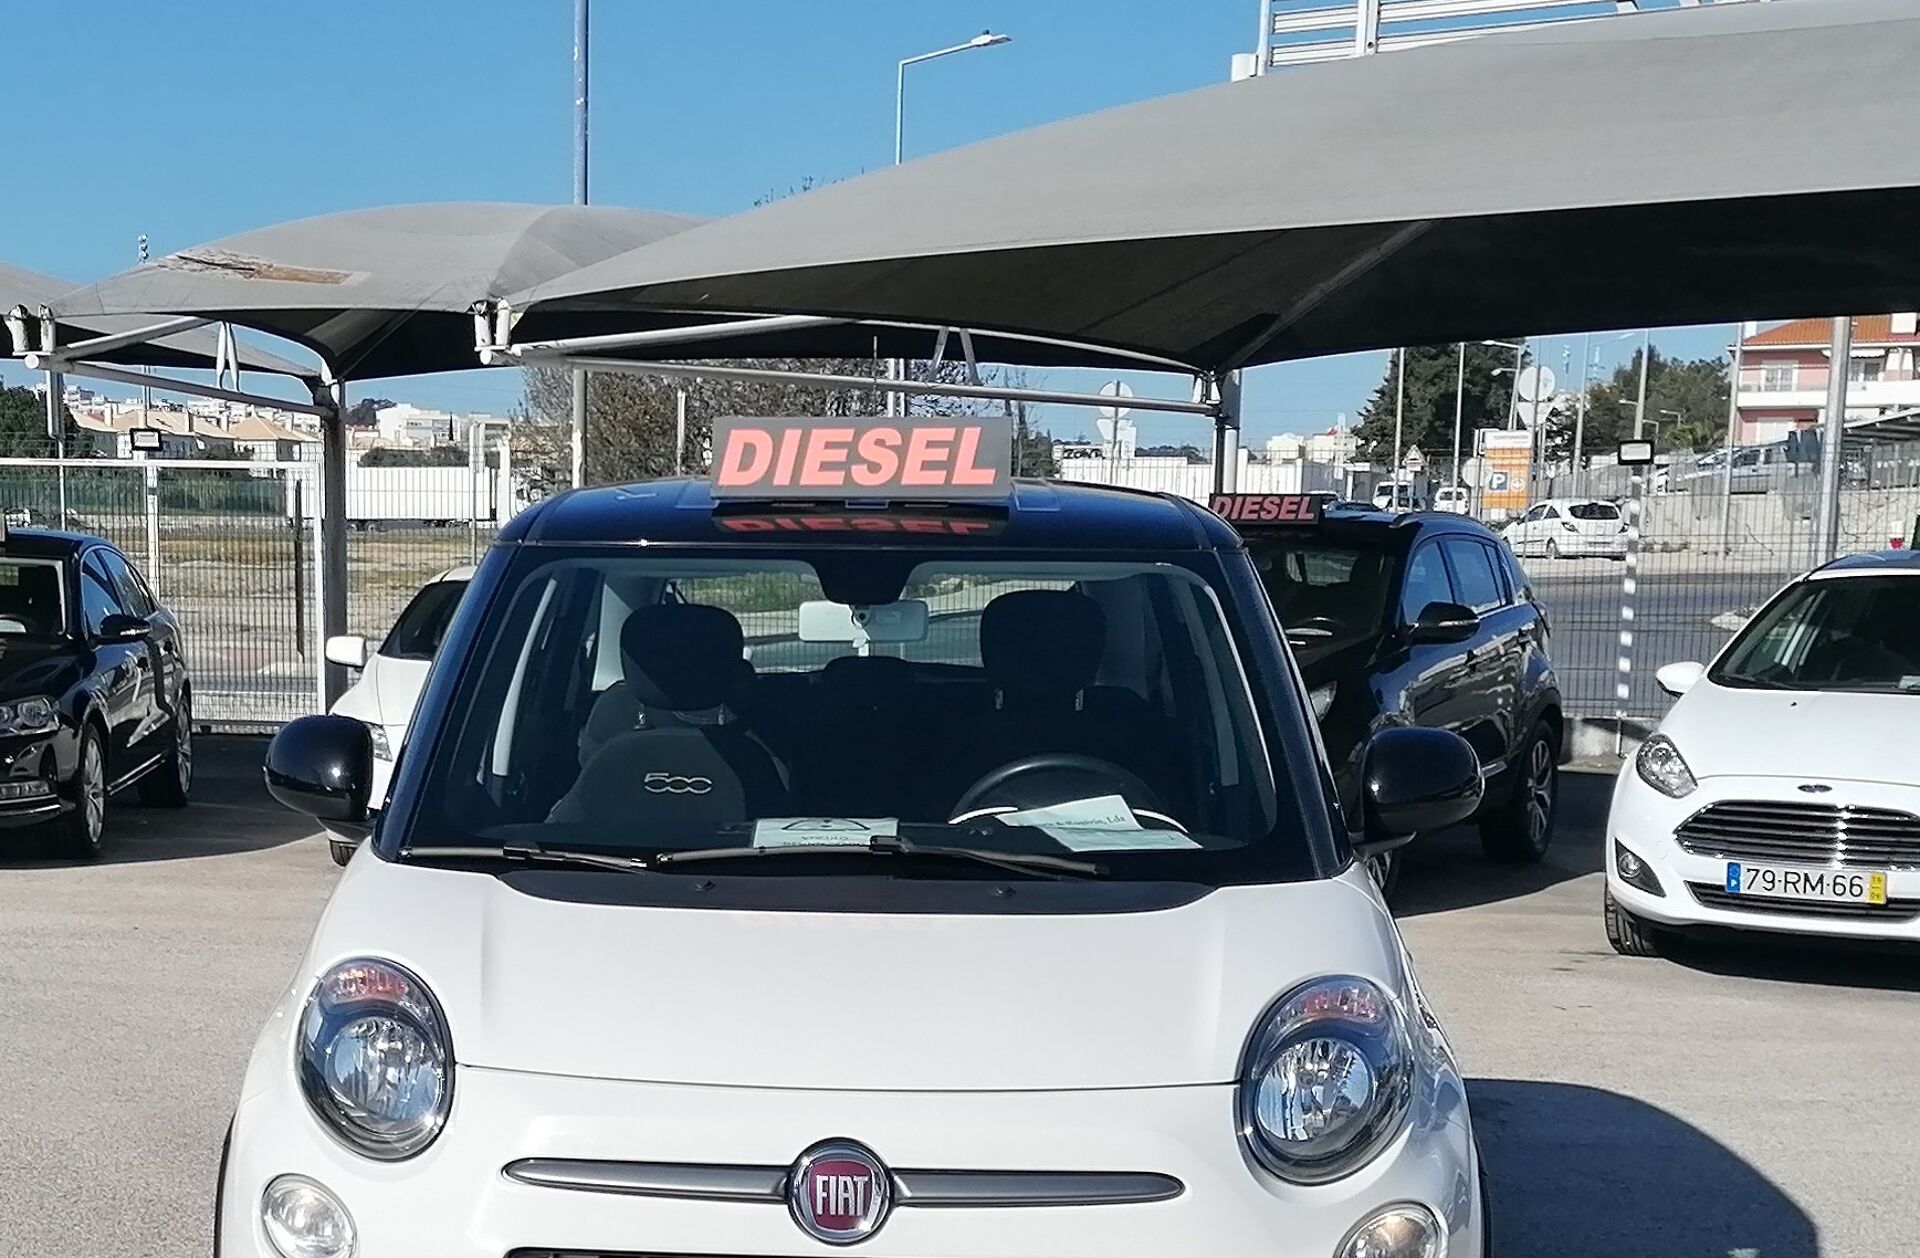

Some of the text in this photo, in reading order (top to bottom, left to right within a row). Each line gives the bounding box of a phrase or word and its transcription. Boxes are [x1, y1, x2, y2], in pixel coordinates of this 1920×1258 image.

[717, 426, 998, 487] DIESEL
[1491, 473, 1506, 489] P
[1211, 495, 1315, 521] DIESEL
[643, 772, 713, 795] 500
[815, 1174, 869, 1217] FIAT
